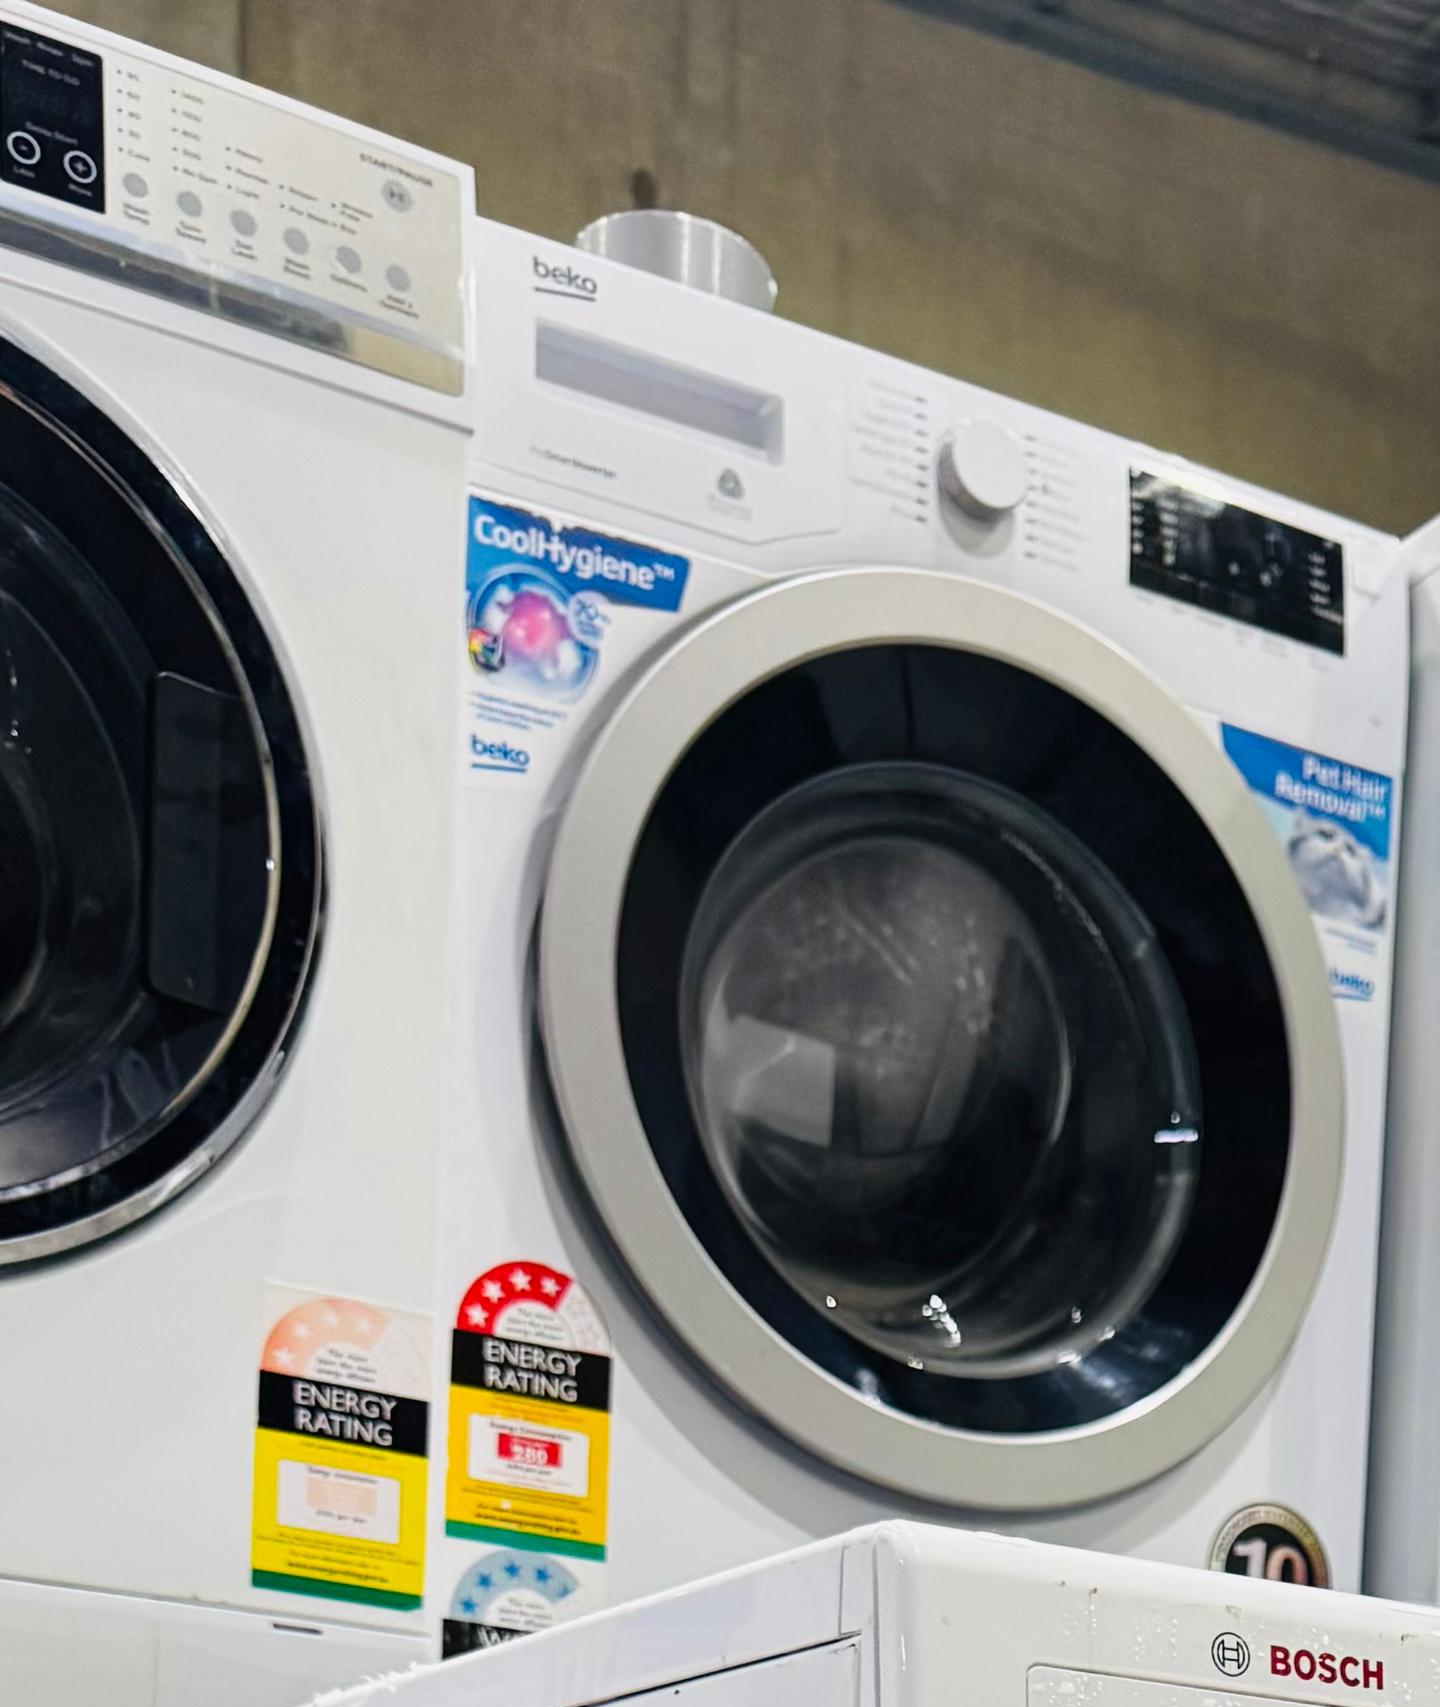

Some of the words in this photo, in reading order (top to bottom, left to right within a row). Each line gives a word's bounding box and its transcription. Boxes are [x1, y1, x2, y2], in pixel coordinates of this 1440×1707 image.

[533, 255, 598, 295] beko
[470, 734, 531, 767] beko
[484, 1336, 582, 1377] ENERGY
[294, 1380, 397, 1420] ENERGY
[485, 1364, 578, 1402] RATING
[295, 1407, 393, 1446] RATING
[1233, 1537, 1308, 1585] 10
[1270, 1645, 1384, 1691] BOSCH
